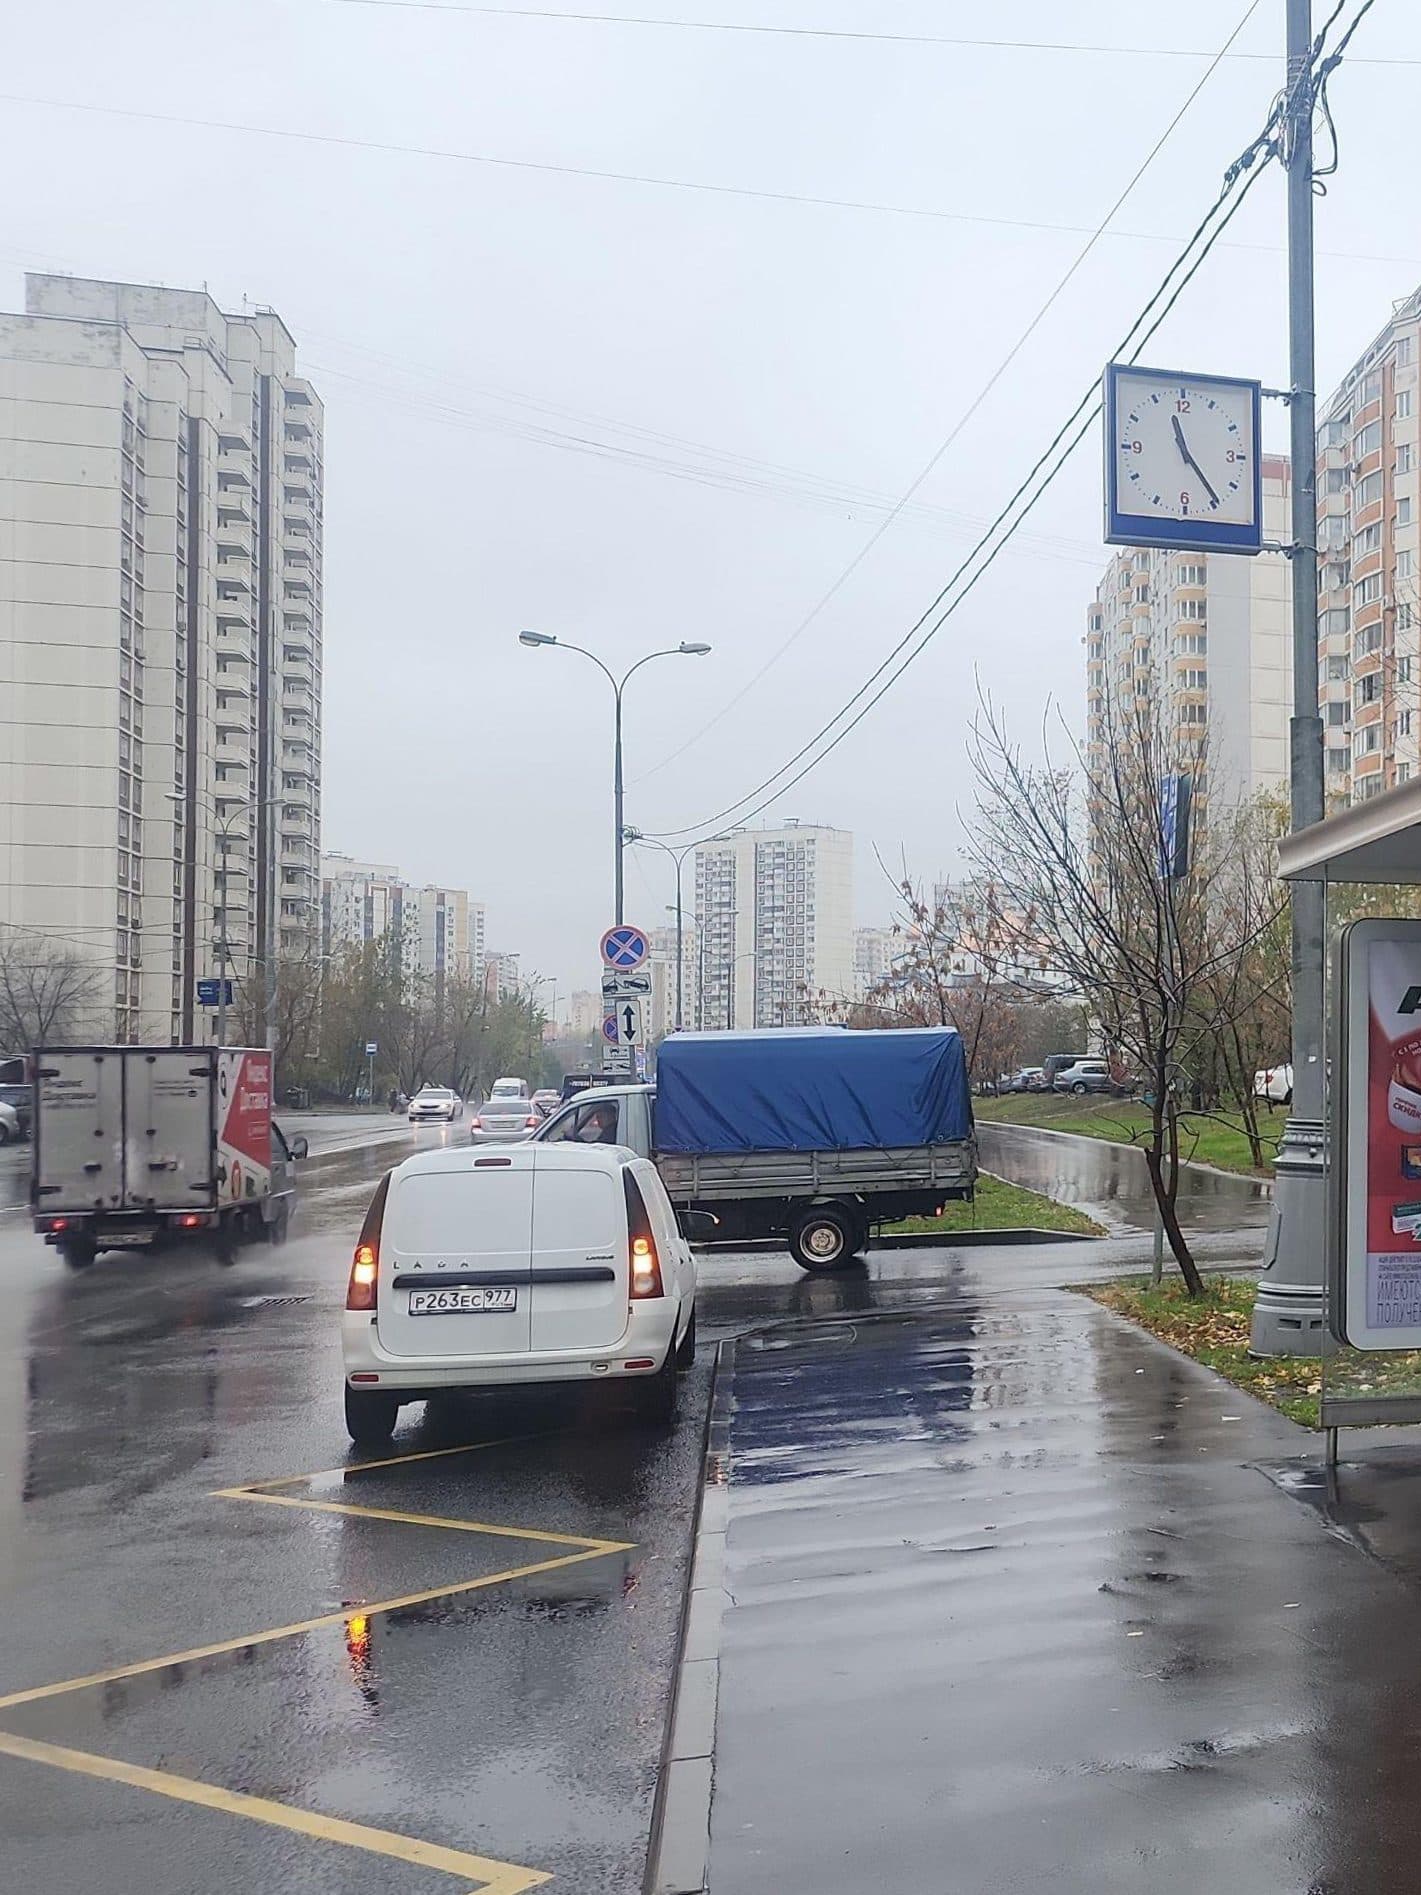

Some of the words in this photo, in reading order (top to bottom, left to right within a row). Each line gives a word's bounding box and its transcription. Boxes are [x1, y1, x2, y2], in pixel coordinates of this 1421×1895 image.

[1176, 400, 1191, 414] 12
[1132, 441, 1142, 454] 9
[1226, 450, 1235, 463] 3
[1180, 492, 1190, 505] 6
